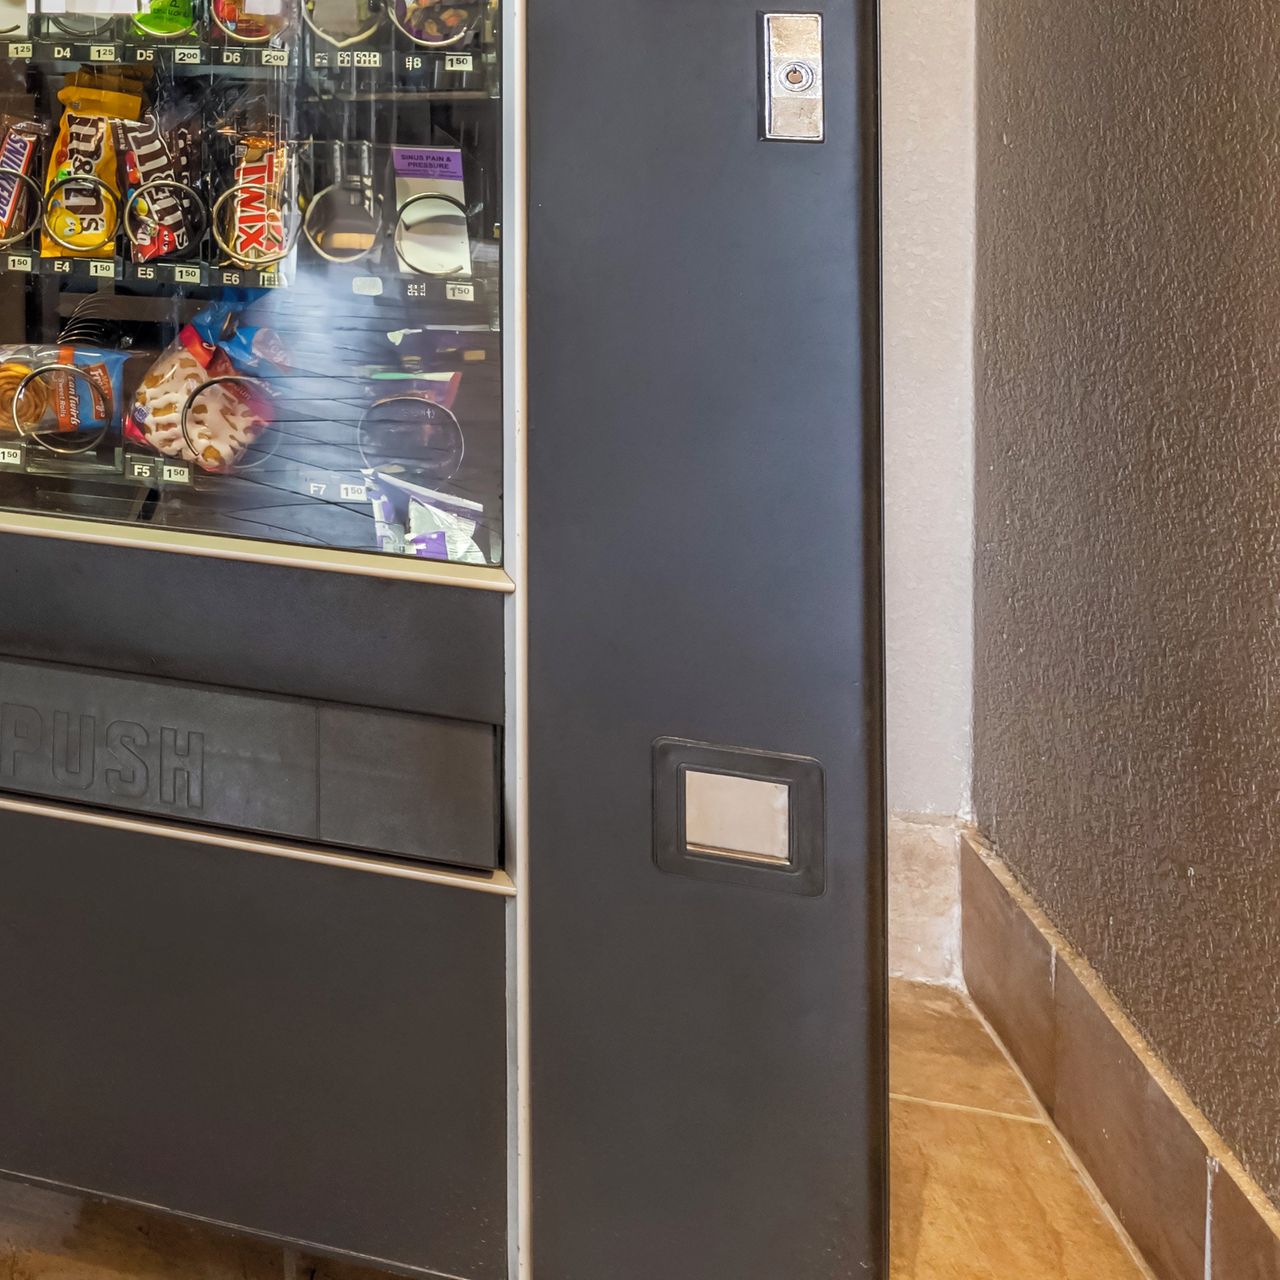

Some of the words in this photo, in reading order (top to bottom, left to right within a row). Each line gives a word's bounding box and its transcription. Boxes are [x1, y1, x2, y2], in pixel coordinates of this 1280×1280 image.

[54, 47, 72, 58] D4
[136, 49, 154, 61] D5
[223, 52, 241, 64] D6
[407, 161, 450, 169] PRESSURE
[235, 153, 275, 253] TWIX
[54, 261, 70, 272] E4
[137, 267, 154, 279] E5
[222, 272, 240, 285] E6
[133, 465, 151, 477] F5
[309, 483, 327, 496] F7
